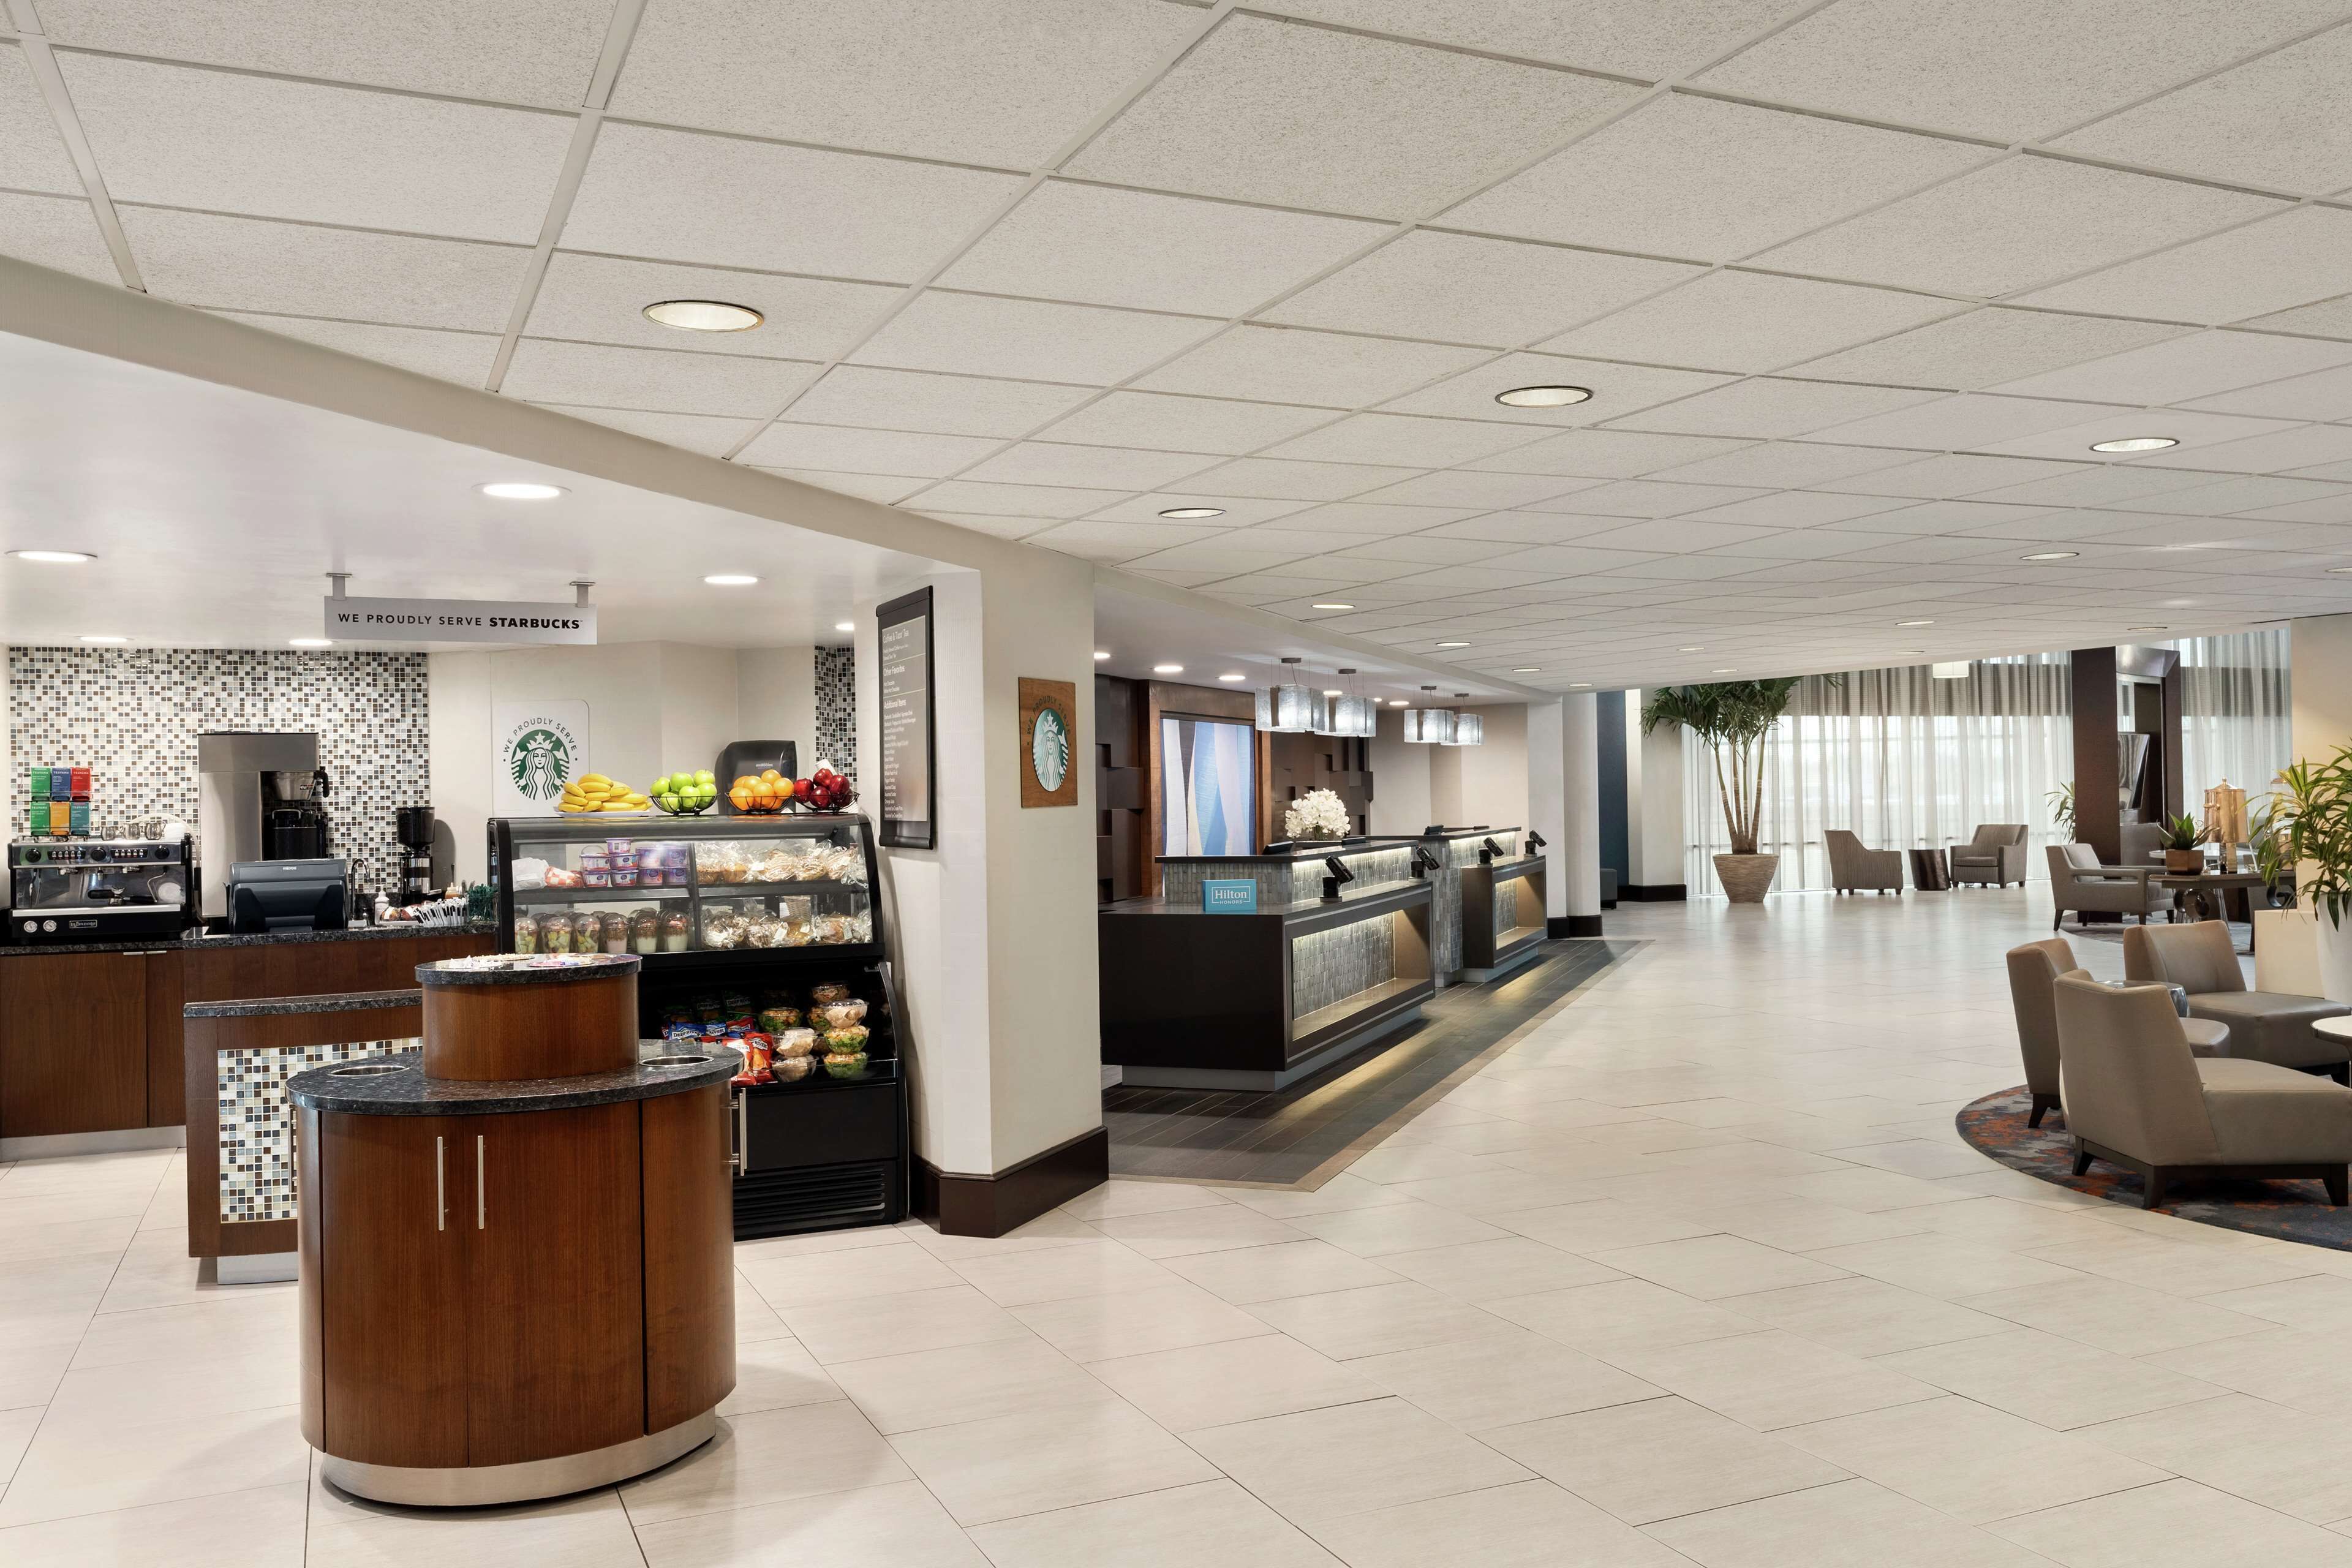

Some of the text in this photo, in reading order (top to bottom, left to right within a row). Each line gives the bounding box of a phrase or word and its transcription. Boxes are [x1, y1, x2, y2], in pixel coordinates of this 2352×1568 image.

[338, 614, 579, 629] WE PROUDLY SERVE STARBUCKS
[1033, 695, 1057, 715] PROUDLY
[503, 717, 577, 753] WE PROUDLY SERVE
[1215, 889, 1247, 899] Hilton
